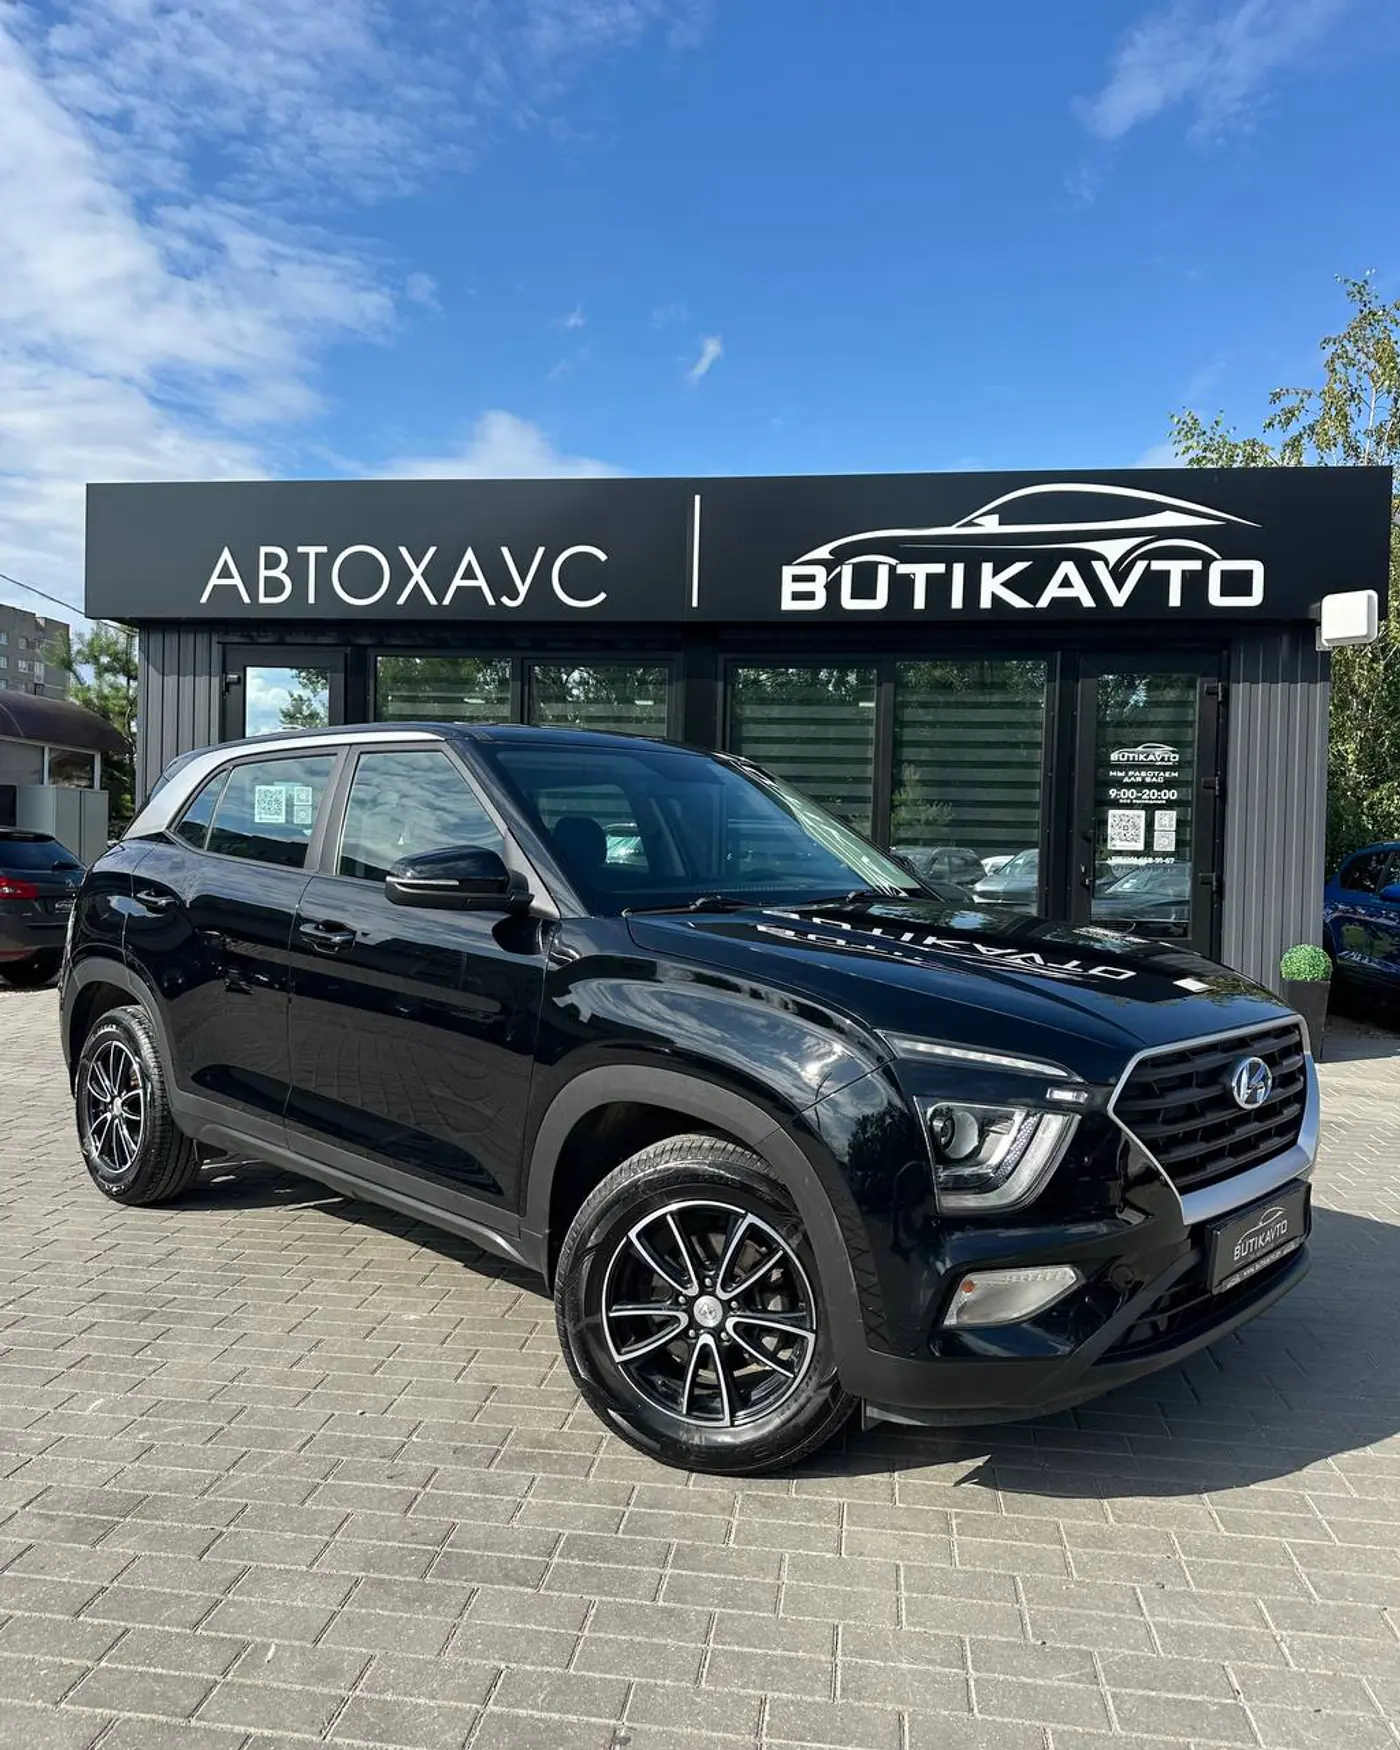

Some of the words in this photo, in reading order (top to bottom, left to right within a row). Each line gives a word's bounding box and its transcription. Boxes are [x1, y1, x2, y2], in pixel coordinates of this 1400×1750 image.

[199, 544, 608, 608] АВТОХАУС
[780, 559, 1265, 611] BUTIKAVTO
[1110, 753, 1179, 761] BUTIKAVTO
[1109, 788, 1178, 799] 9:00-20:00
[1232, 1219, 1288, 1261] BUTIKAVTO
